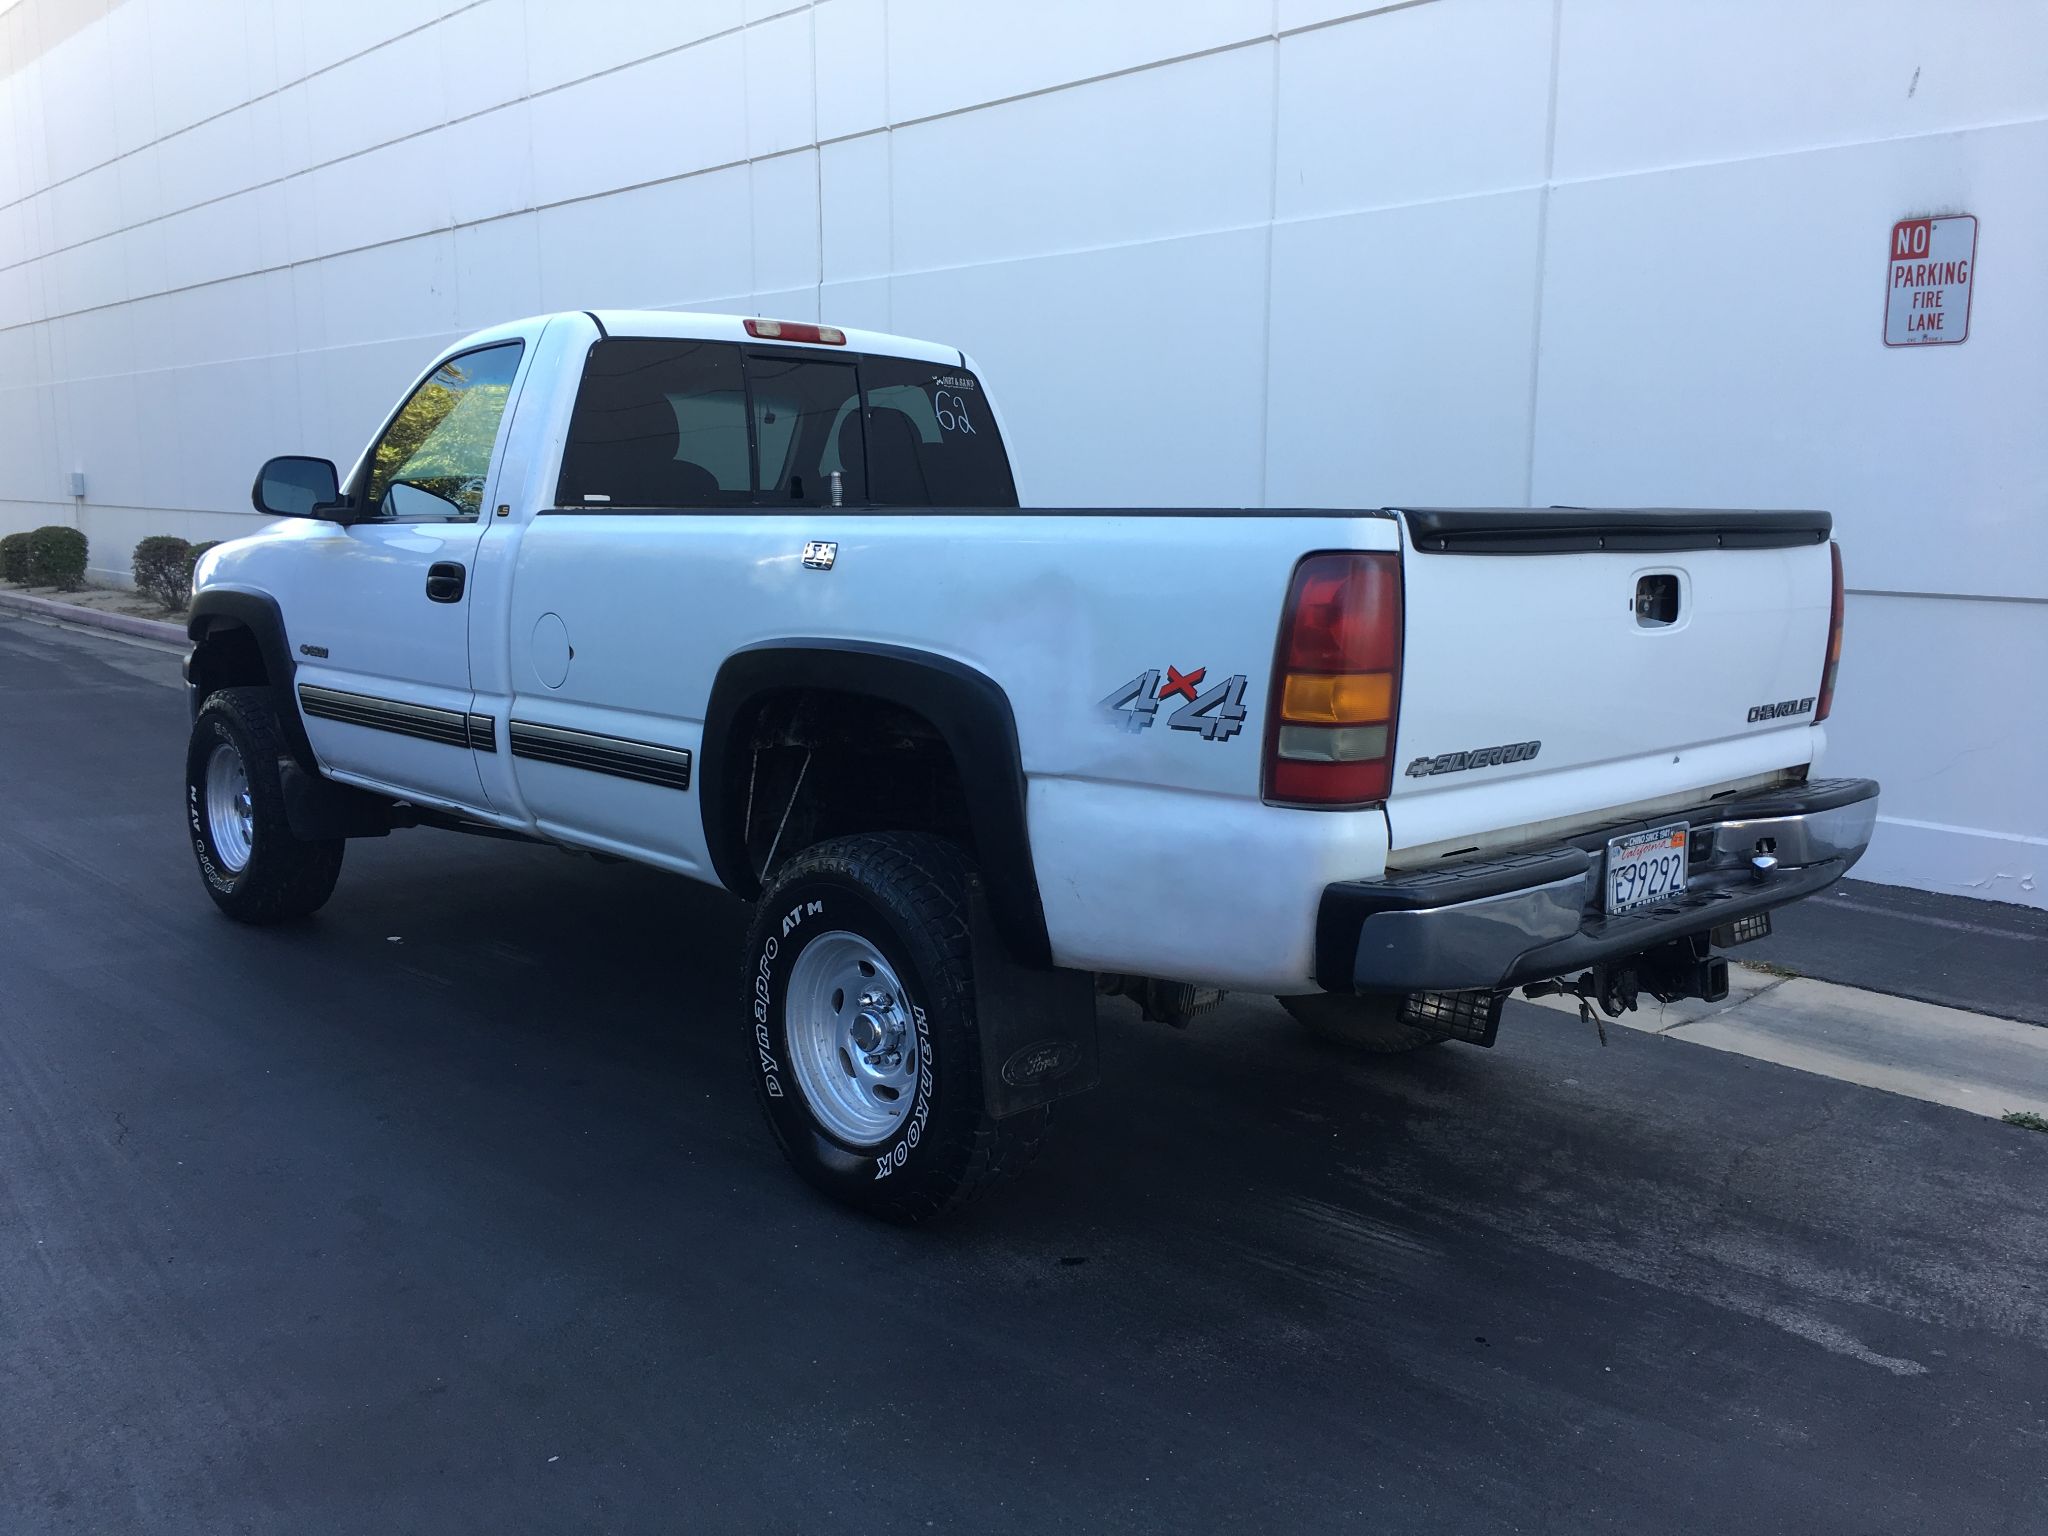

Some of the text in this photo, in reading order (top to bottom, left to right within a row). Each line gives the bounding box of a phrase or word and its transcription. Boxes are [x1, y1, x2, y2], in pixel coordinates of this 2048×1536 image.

[1896, 225, 1927, 255] NO
[1894, 260, 1968, 289] PARKING
[1912, 290, 1945, 309] FIRE
[1907, 312, 1945, 332] LANE
[935, 390, 976, 435] 62
[1747, 696, 1817, 723] CHEVROLET
[1429, 740, 1542, 776] SILVERADO
